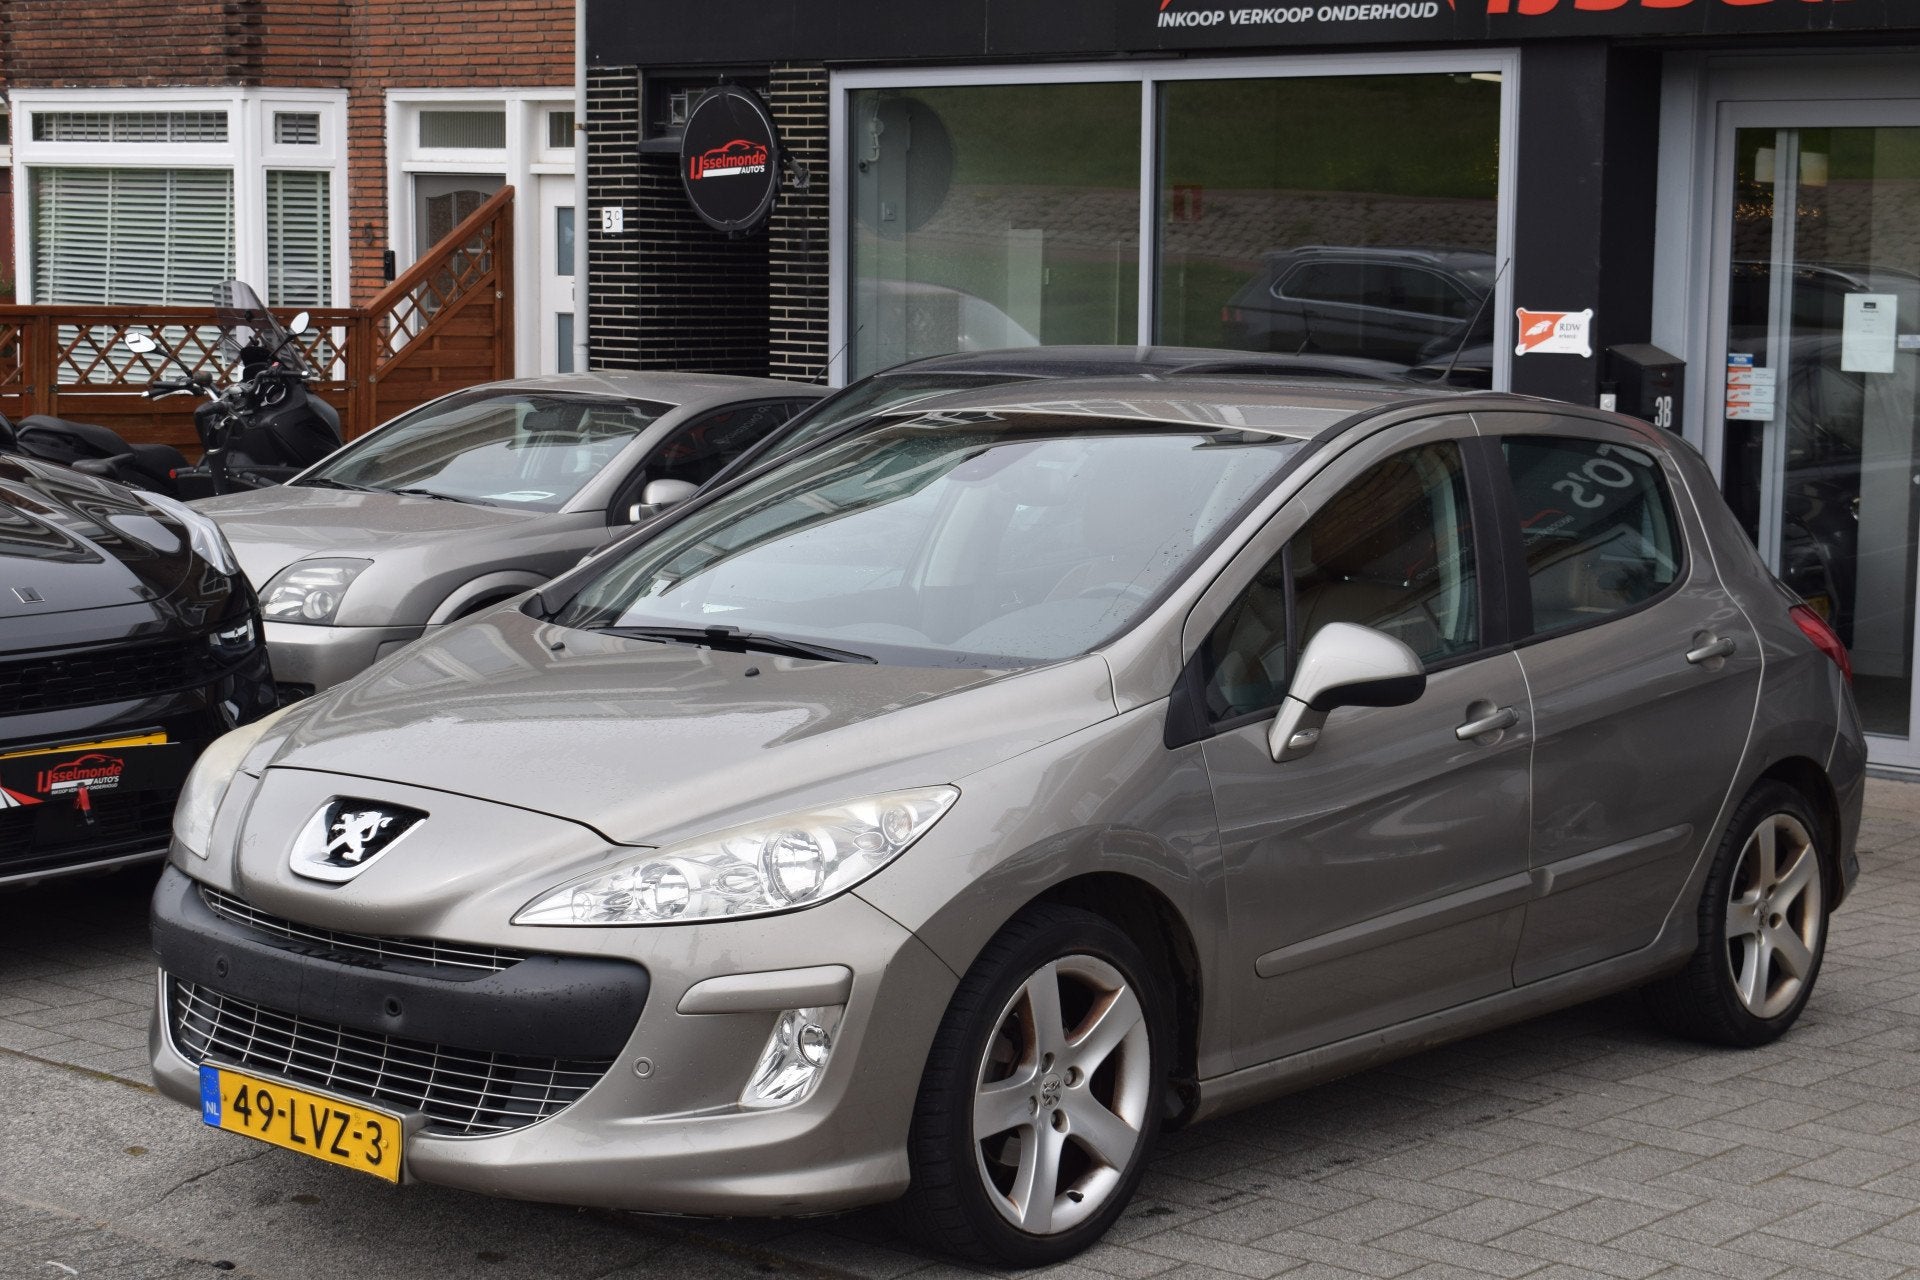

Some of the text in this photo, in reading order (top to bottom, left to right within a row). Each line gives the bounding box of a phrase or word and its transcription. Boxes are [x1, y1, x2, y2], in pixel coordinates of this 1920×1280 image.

[1157, 2, 1438, 27] INKOOP VERKOOP ONDERHOUD
[690, 151, 766, 179] IJsselmonde
[741, 165, 765, 174] AUTO'S
[1560, 323, 1581, 331] RDW
[1655, 396, 1672, 427] 3B
[37, 764, 122, 792] IJsselmonde
[93, 776, 120, 784] AUTO'S
[205, 1101, 220, 1116] NL
[233, 1084, 382, 1166] 49-LVZ-3
